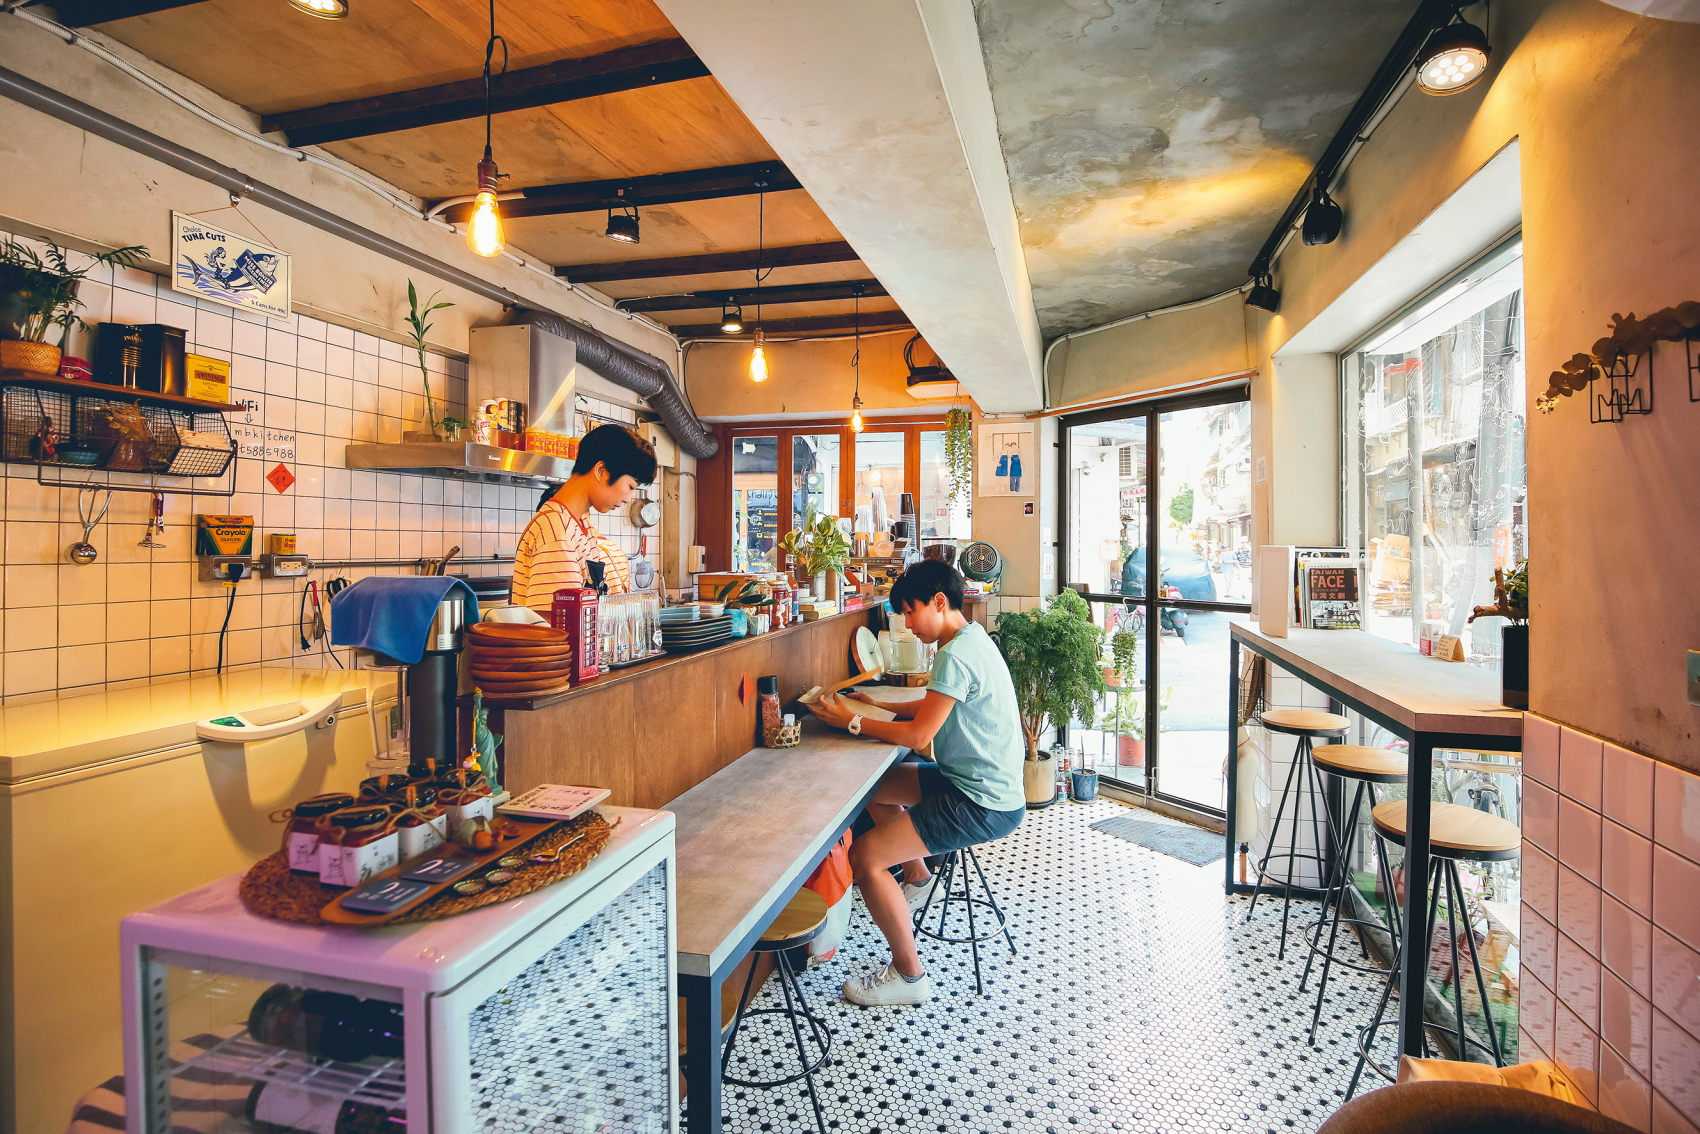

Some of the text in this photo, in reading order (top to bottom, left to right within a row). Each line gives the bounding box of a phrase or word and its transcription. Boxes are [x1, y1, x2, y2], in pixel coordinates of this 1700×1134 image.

[182, 225, 202, 233] Choice
[181, 231, 226, 243] TUNA CUTS
[255, 301, 268, 309] Cans
[235, 399, 258, 412] WiFi
[239, 443, 294, 459] t5885988
[215, 528, 246, 537] Crayola
[1310, 575, 1346, 588] FACE
